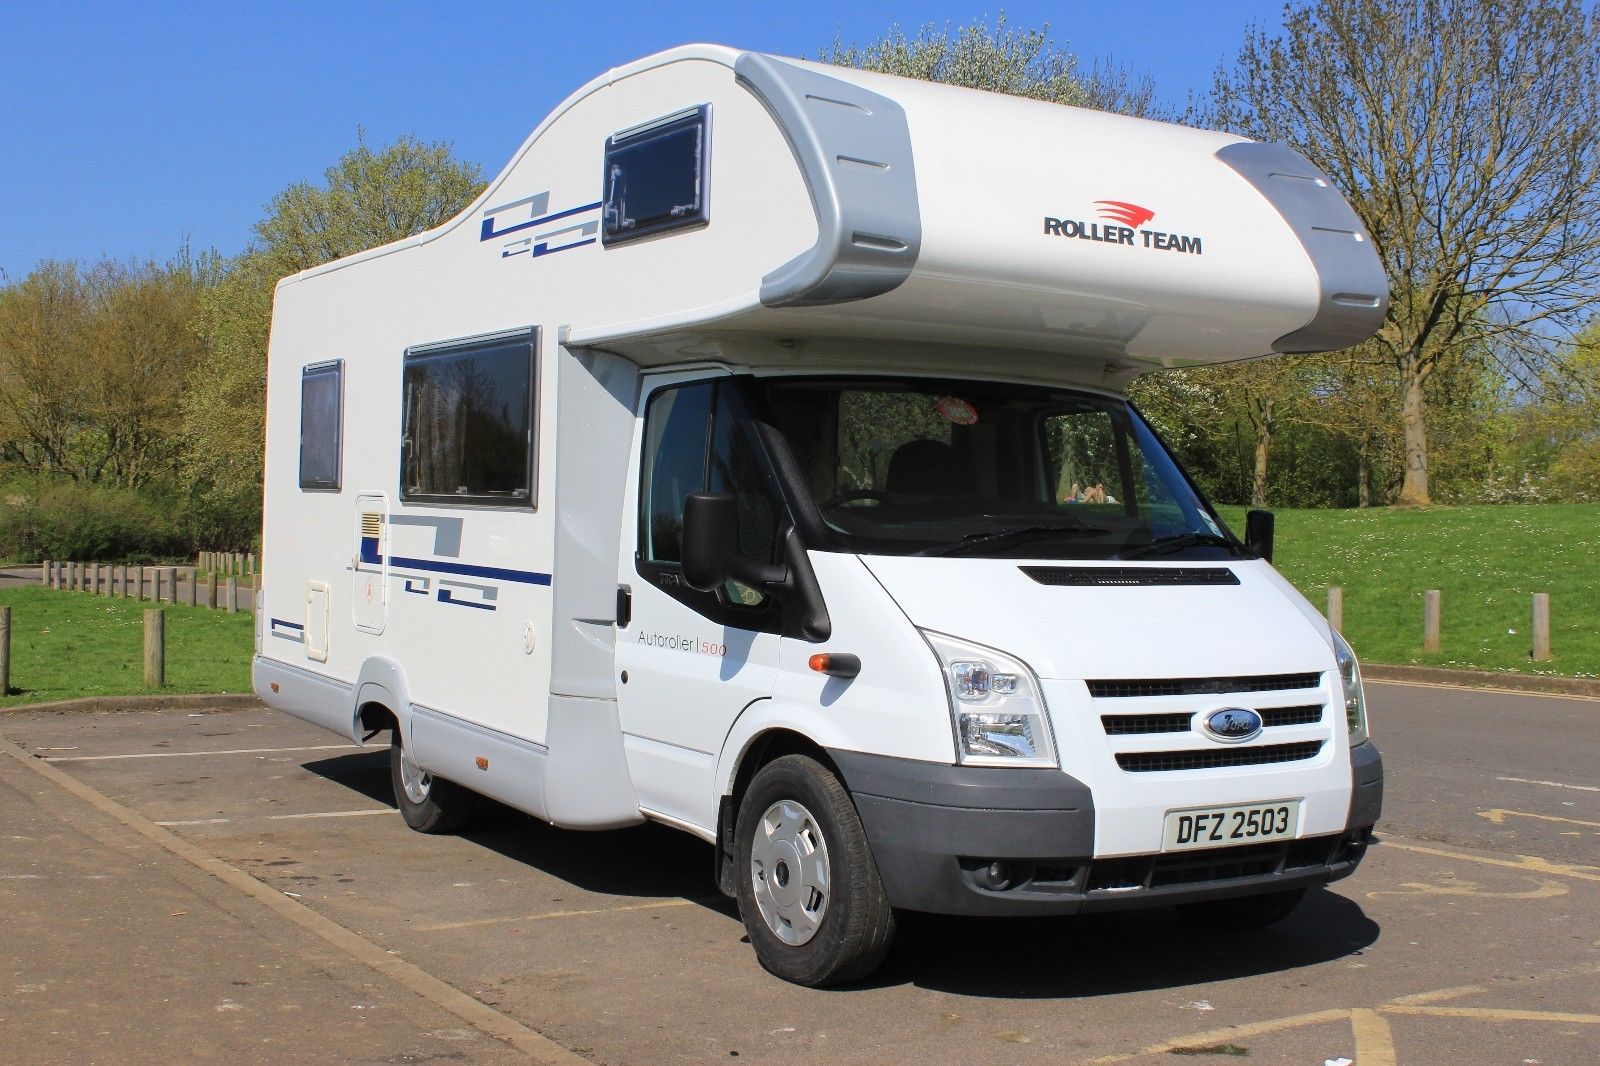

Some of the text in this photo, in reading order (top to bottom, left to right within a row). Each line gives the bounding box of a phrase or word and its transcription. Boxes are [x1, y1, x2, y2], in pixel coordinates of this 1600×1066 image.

[1044, 216, 1202, 255] ROLLER TEAM
[638, 631, 727, 656] Autoroller 500
[1176, 806, 1289, 844] DFZ 2503
